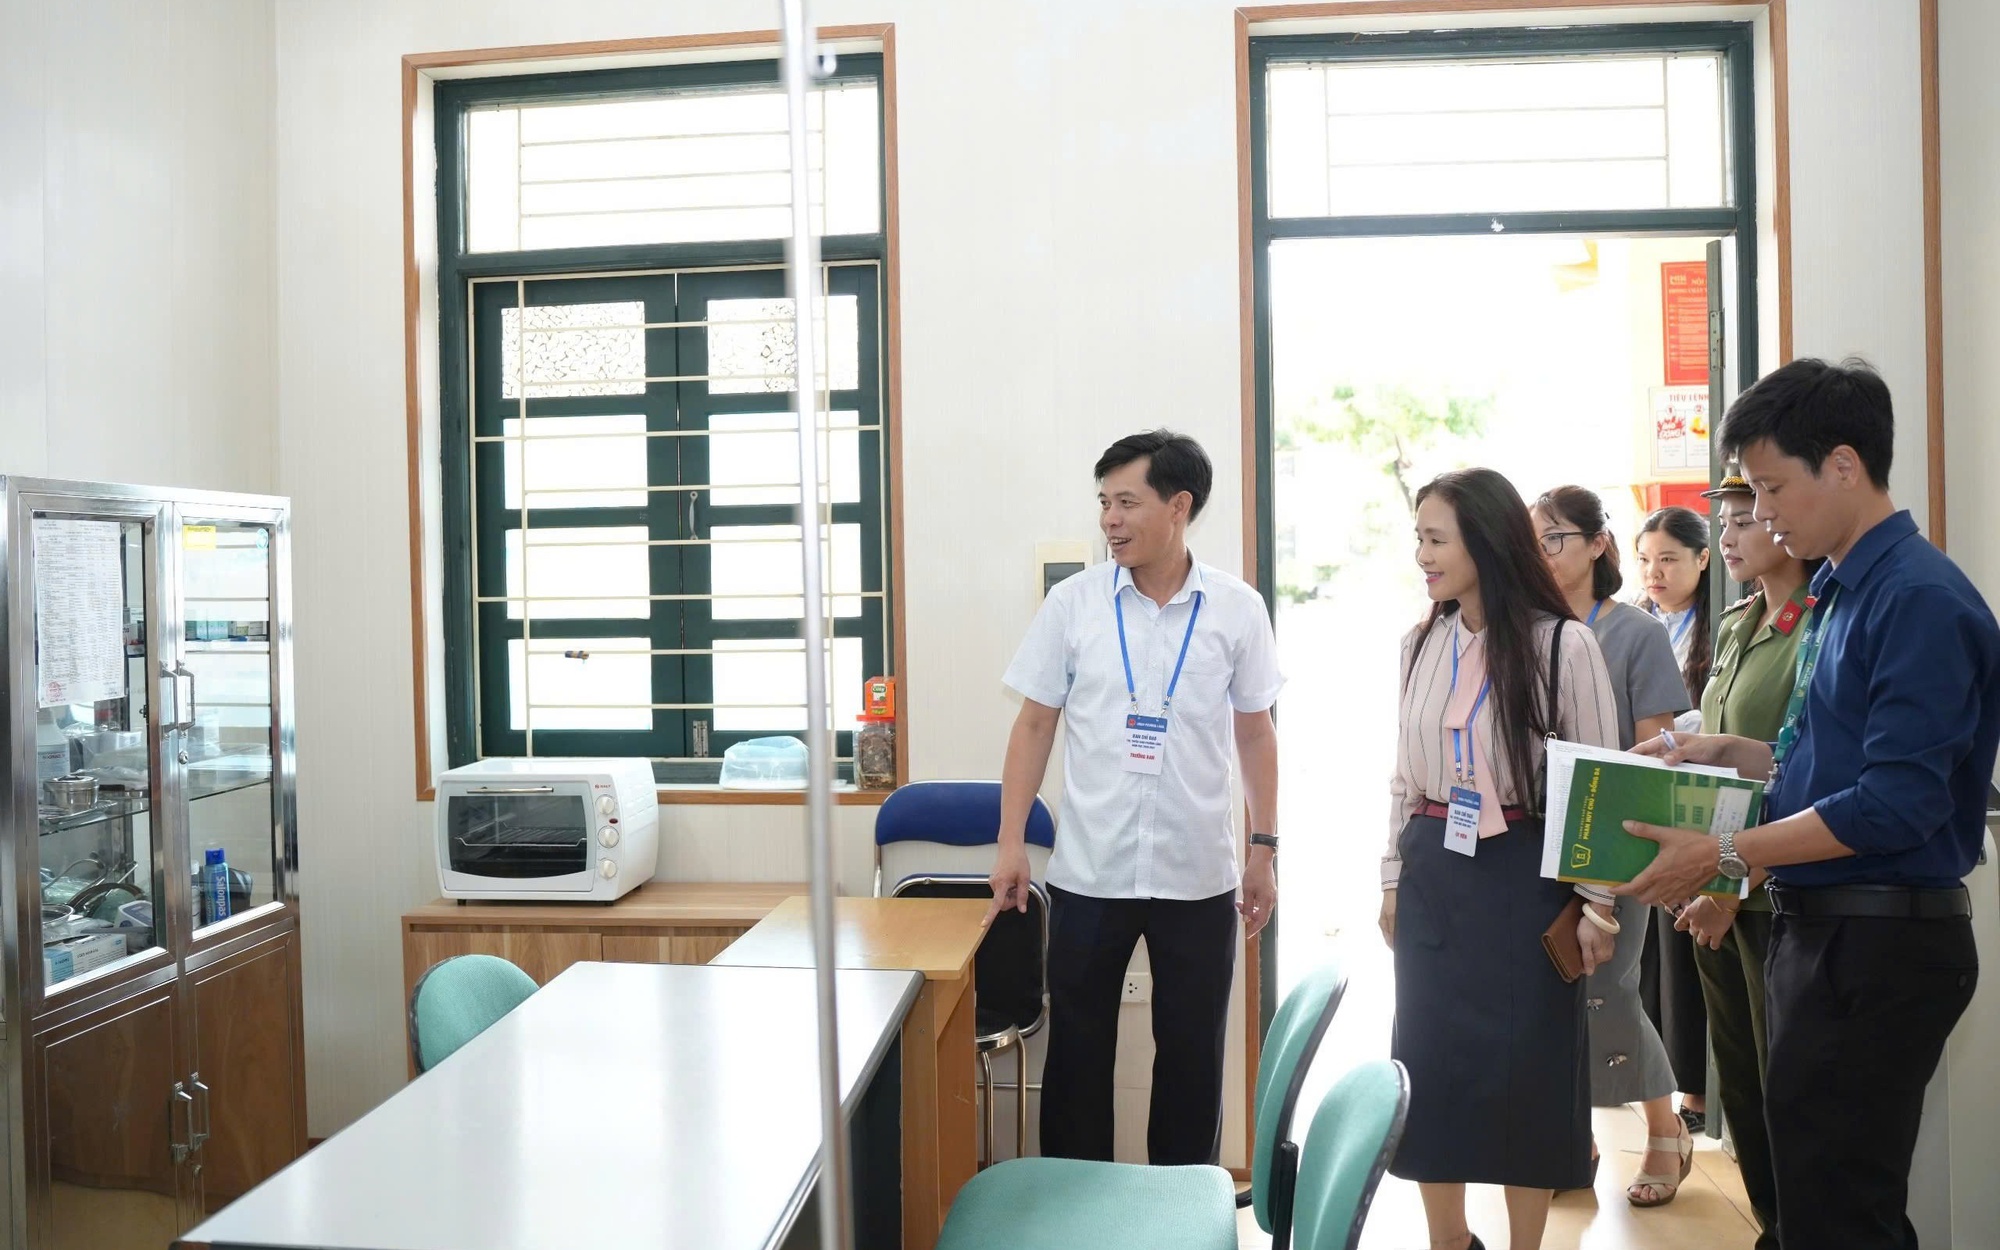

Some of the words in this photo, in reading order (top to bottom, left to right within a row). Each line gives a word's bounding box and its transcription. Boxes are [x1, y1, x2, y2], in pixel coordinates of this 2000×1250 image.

[1585, 810, 1593, 822] HUY
[1582, 823, 1591, 840] PHAN
[215, 876, 226, 917] Salonpas
